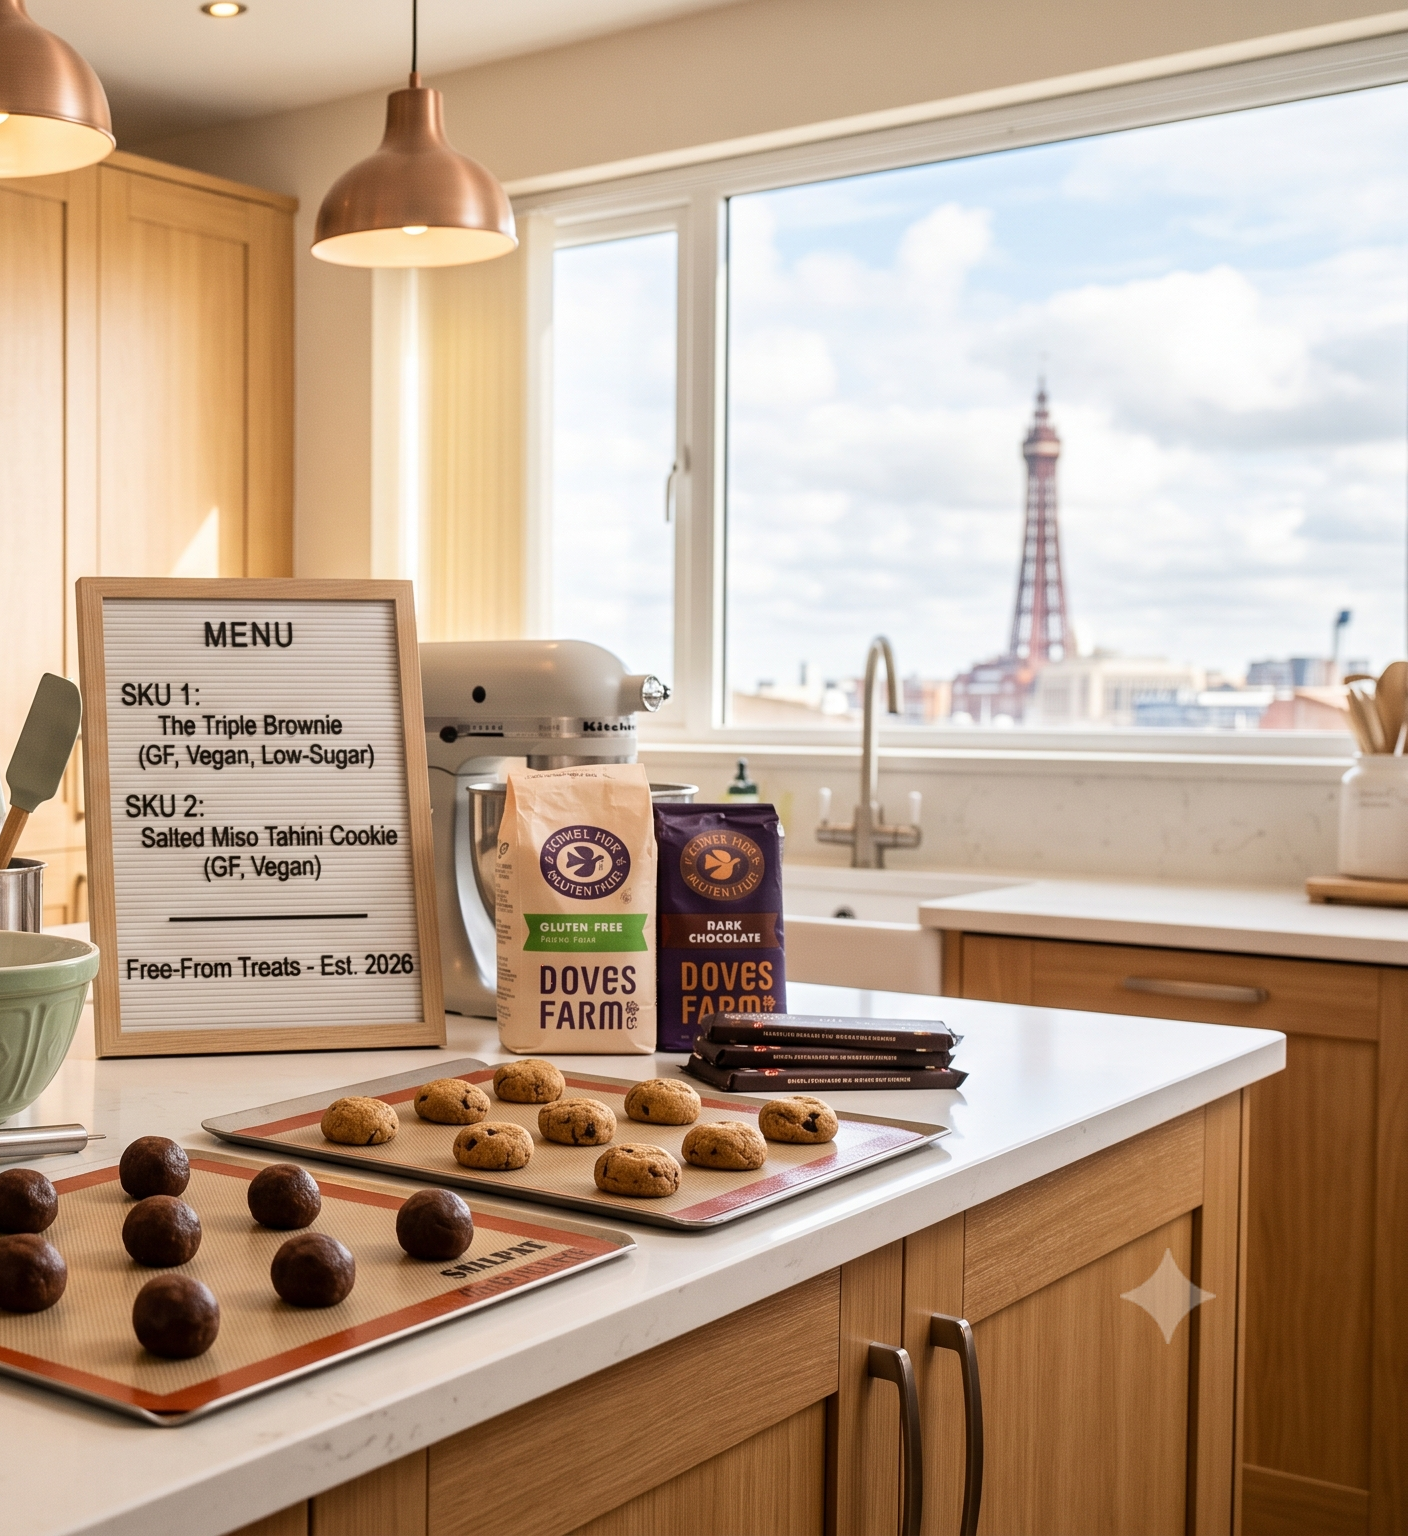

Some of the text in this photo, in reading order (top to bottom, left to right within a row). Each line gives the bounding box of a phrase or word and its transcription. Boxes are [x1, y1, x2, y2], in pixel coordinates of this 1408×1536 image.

[205, 622, 292, 647] MENU
[122, 683, 199, 706] SKU 1:
[158, 715, 342, 739] The Triple Brownie
[139, 744, 374, 770] (GF, Vegan, Low-Sugar)
[126, 794, 204, 818] SKU 2:
[142, 825, 397, 848] Salted Miso Tahini Cookie
[204, 855, 321, 882] (GF, Vegan)
[539, 922, 623, 933] GLUTEN FREE
[688, 933, 761, 943] CHOCOLATE
[127, 958, 231, 979] Free-From
[238, 957, 301, 977] Treats
[321, 955, 357, 975] Est.
[365, 953, 414, 974] 2026
[682, 961, 773, 991] DOVES
[540, 965, 636, 995] DOVES
[540, 1001, 622, 1029] FARM
